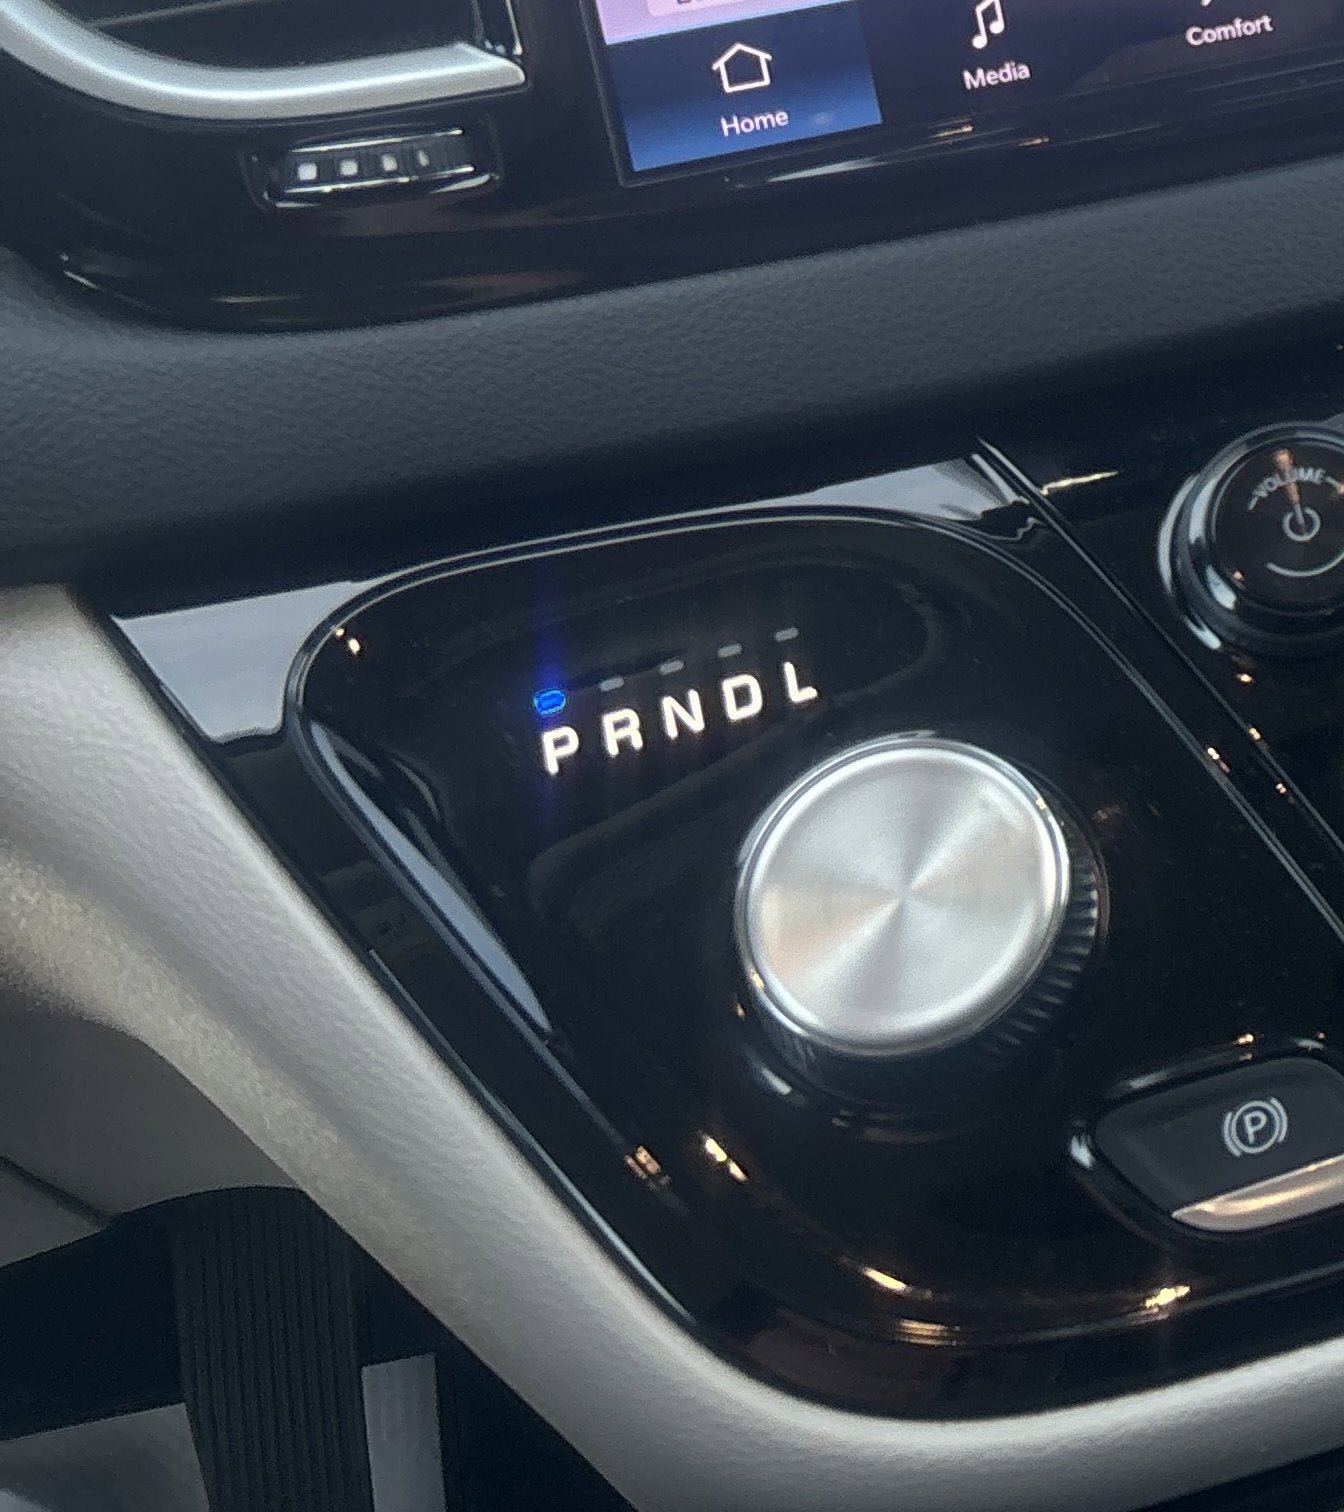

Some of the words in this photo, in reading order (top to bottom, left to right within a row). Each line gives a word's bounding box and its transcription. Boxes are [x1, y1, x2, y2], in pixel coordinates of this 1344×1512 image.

[1186, 13, 1274, 48] Comfort
[963, 60, 1031, 90] Media
[720, 107, 790, 138] Home
